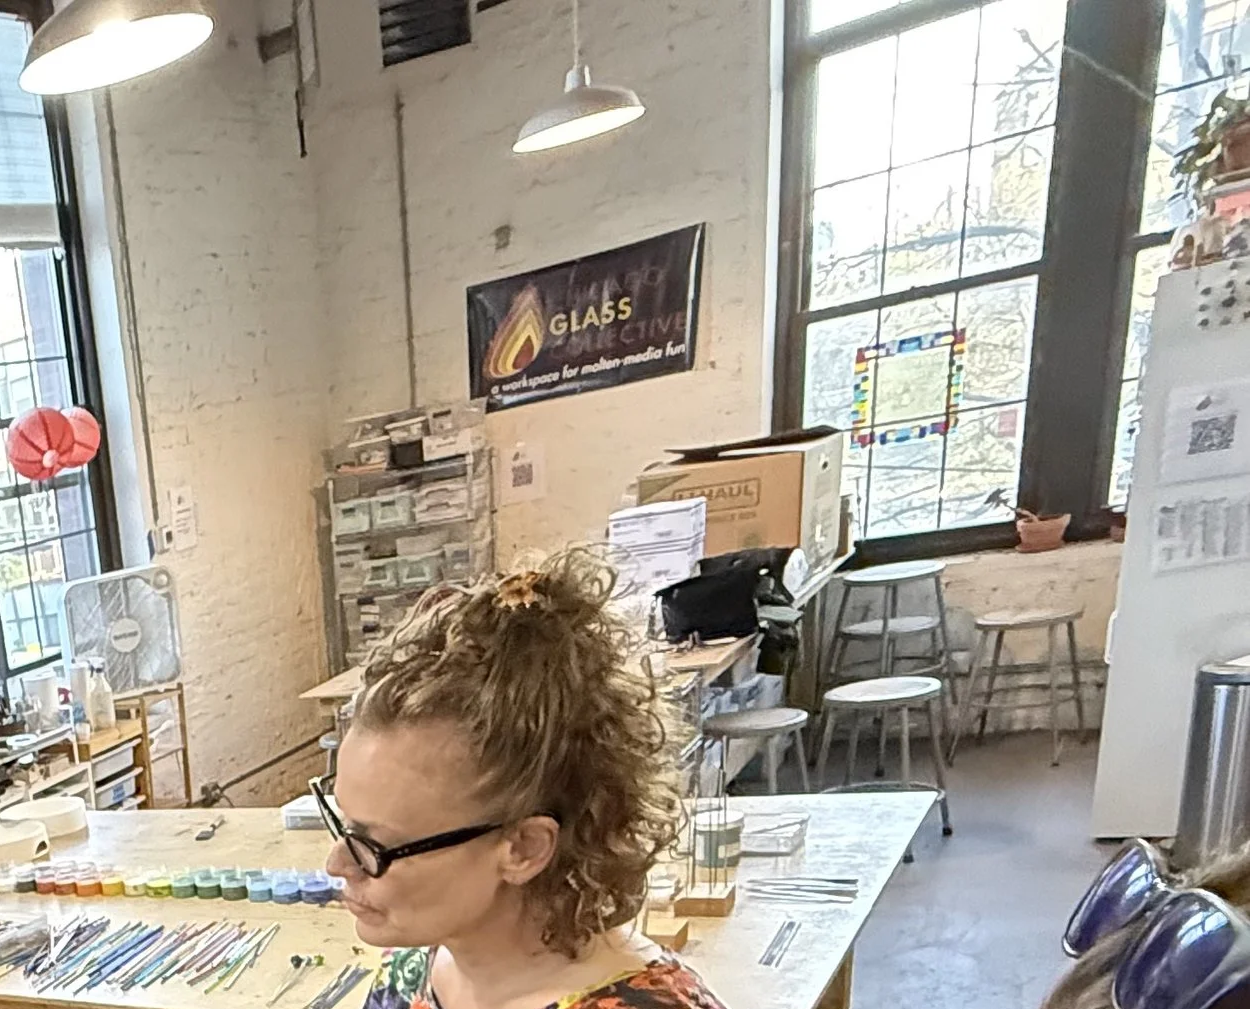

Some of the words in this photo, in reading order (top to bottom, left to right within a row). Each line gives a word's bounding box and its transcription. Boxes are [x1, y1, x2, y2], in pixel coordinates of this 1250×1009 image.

[549, 296, 632, 335] GLASS
[502, 371, 560, 391] workspace
[562, 364, 579, 380] for
[665, 340, 686, 357] fun
[678, 484, 754, 501] HAUL
